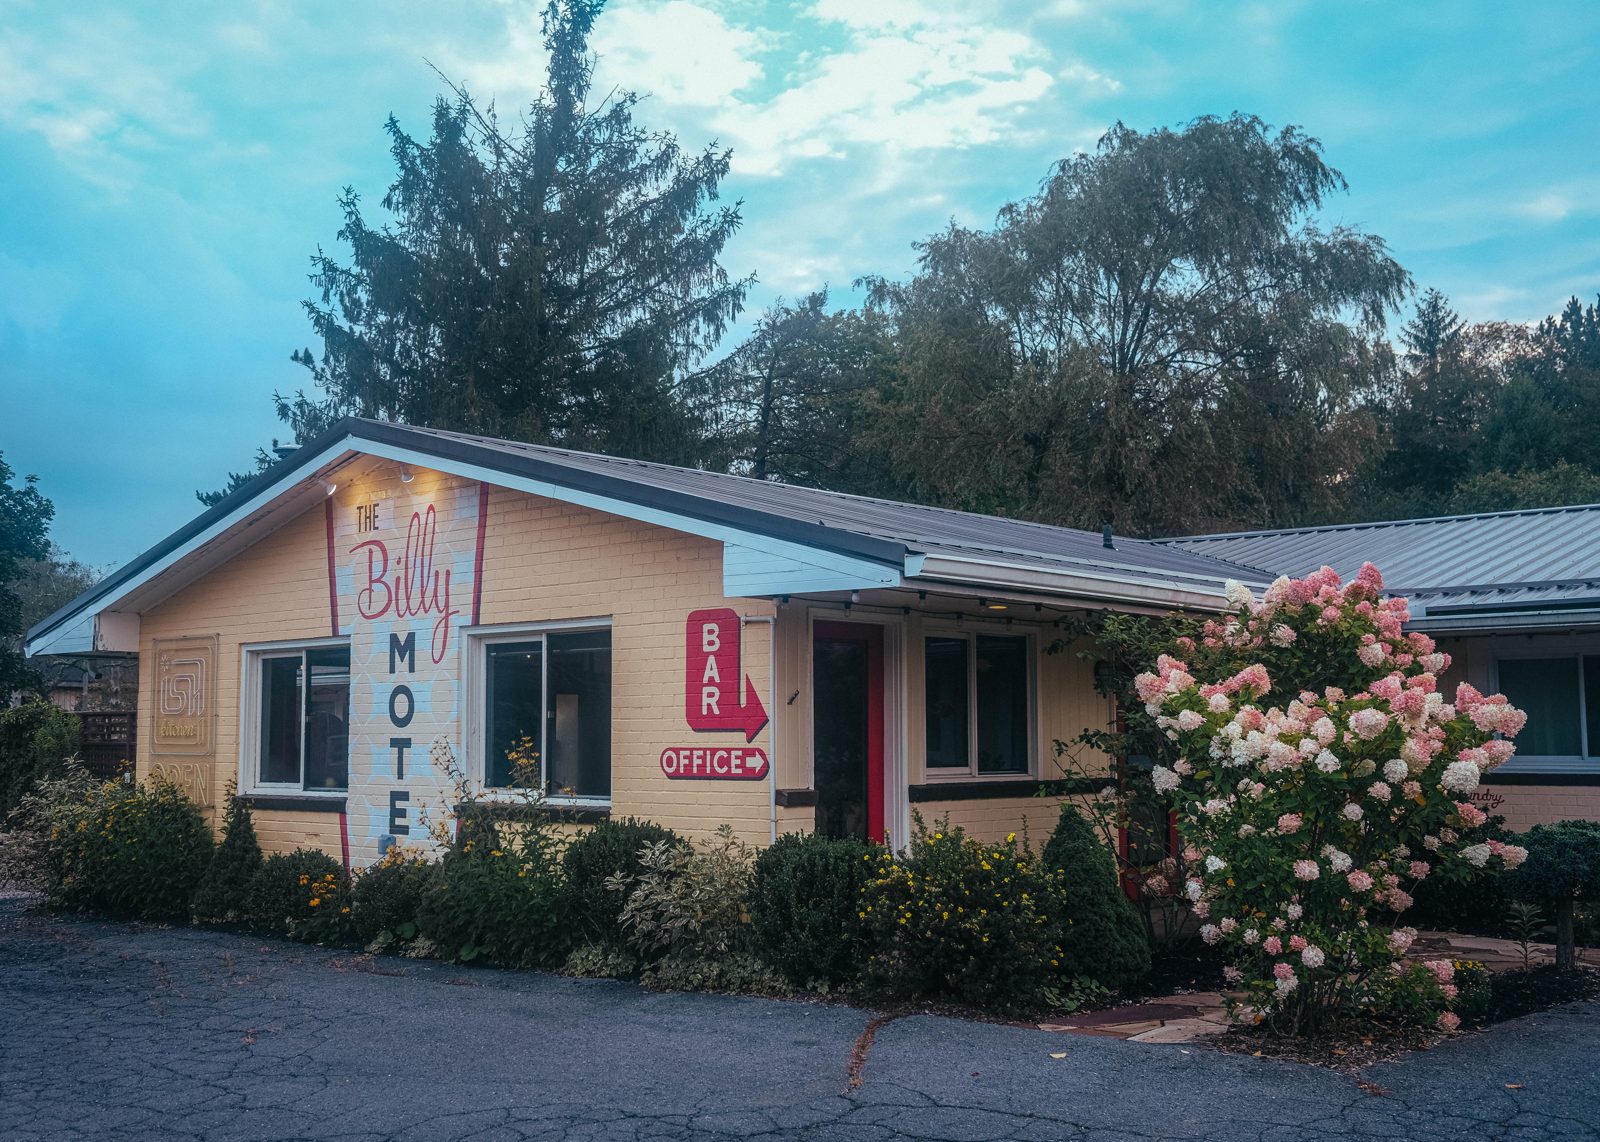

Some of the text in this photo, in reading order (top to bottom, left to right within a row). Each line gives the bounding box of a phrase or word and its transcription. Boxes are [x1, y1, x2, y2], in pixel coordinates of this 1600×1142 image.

[356, 502, 380, 533] THE
[349, 503, 460, 665] Billy
[702, 622, 721, 716] BAR
[662, 750, 743, 774] OFFICE
